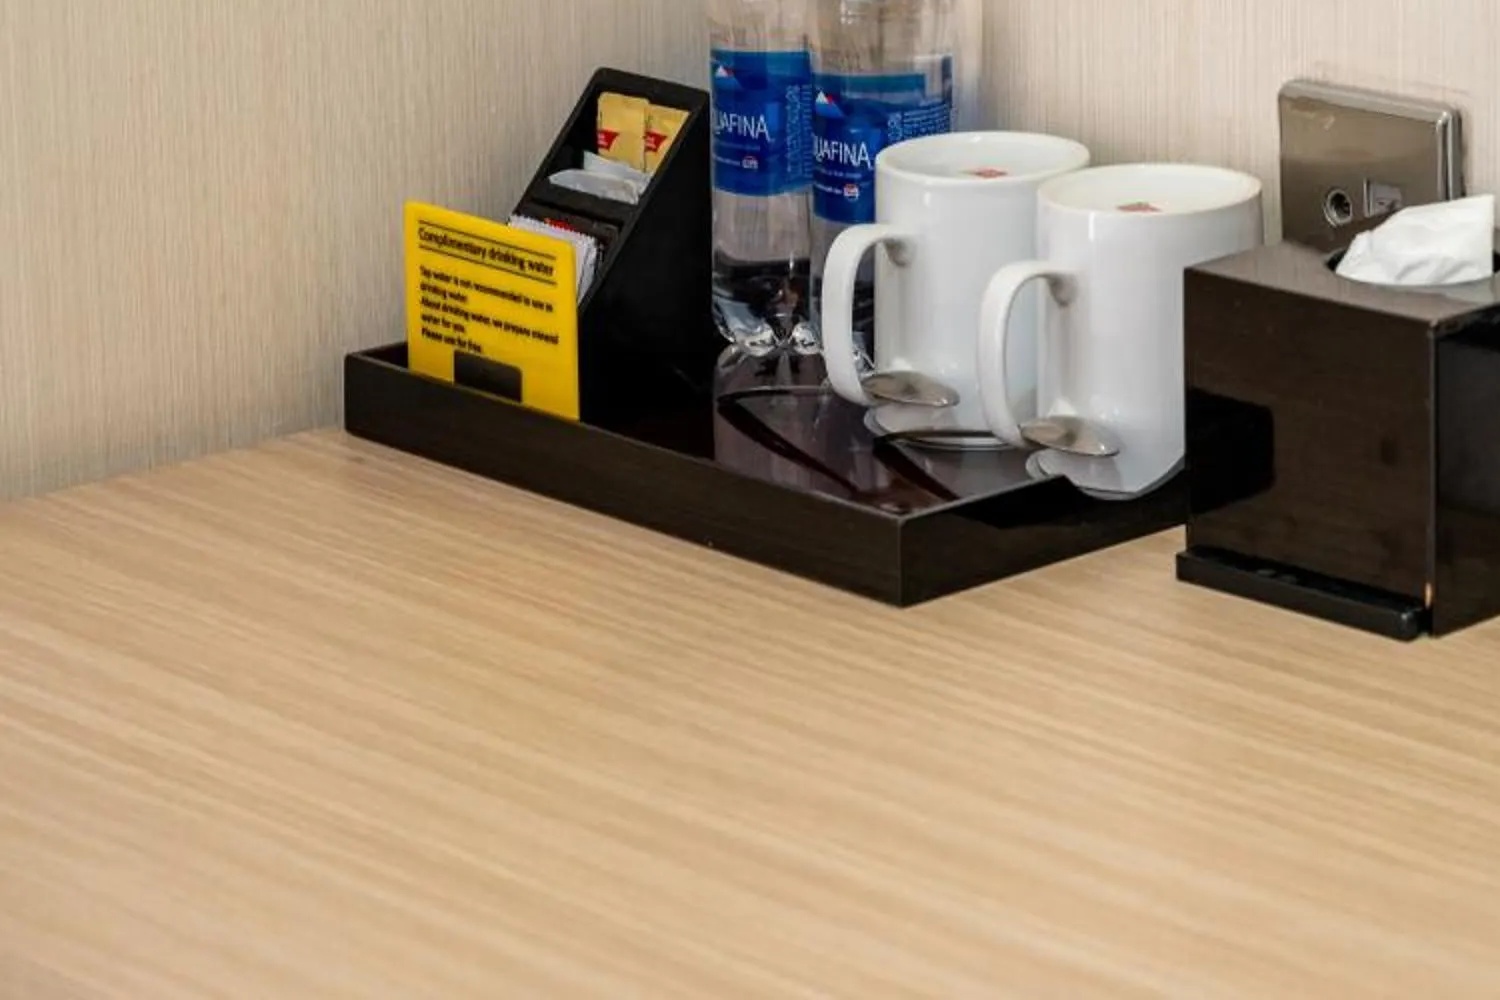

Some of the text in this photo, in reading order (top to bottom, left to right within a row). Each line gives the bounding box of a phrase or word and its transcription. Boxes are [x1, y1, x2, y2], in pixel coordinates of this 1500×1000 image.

[812, 135, 872, 170] UAFINA
[489, 247, 524, 271] drinking
[528, 260, 553, 276] water
